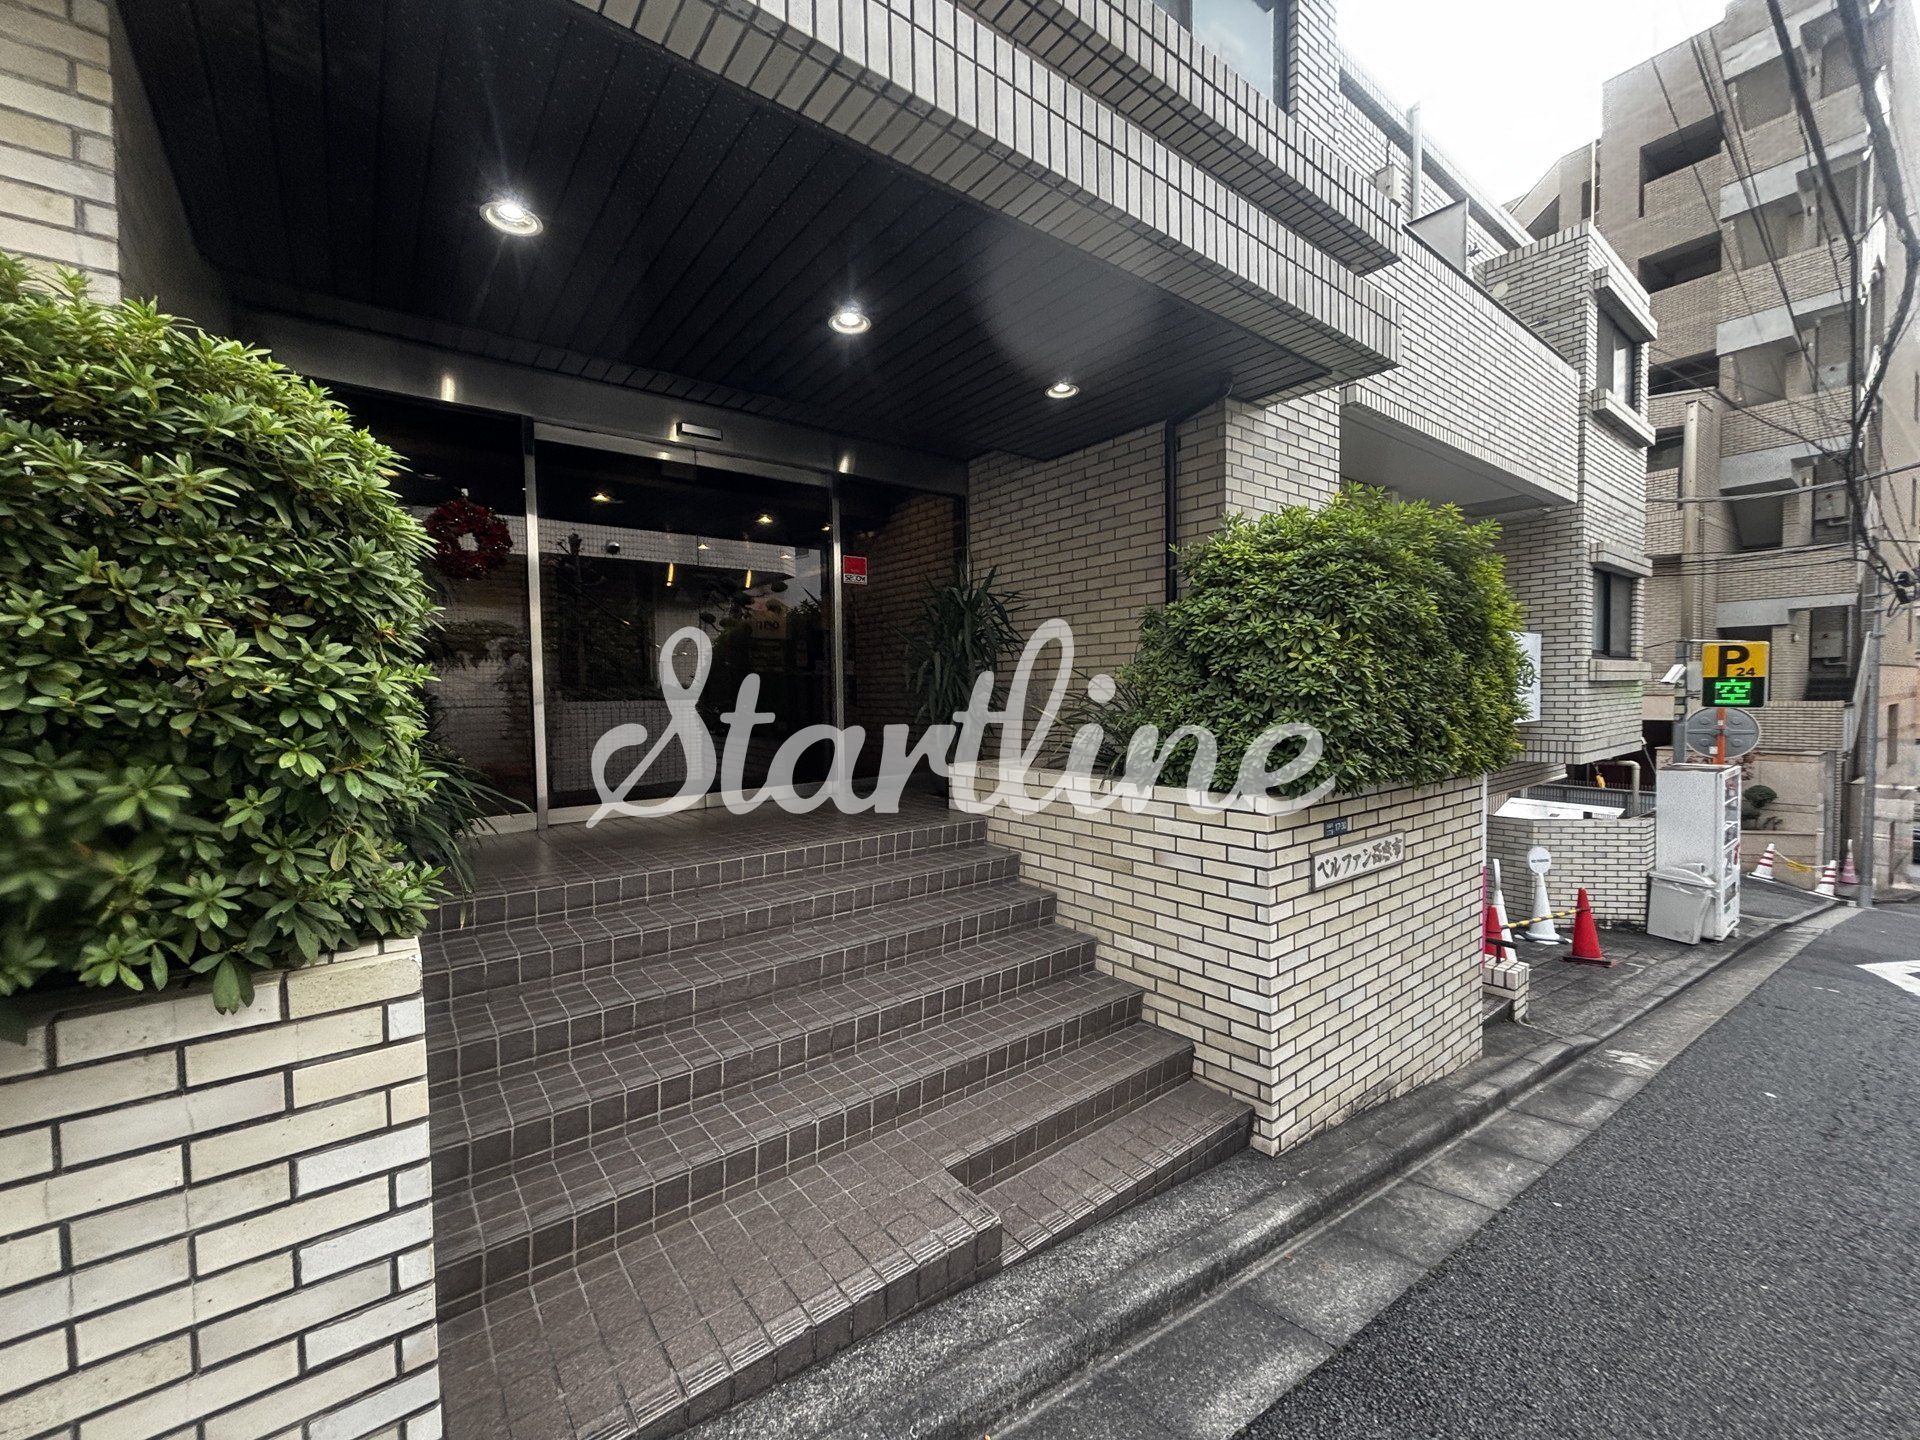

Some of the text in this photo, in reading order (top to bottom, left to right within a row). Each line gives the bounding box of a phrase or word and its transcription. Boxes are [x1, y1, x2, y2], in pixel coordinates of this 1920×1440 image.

[845, 574, 866, 583] SEOM
[1718, 645, 1755, 677] P 24
[1714, 679, 1751, 704] 空
